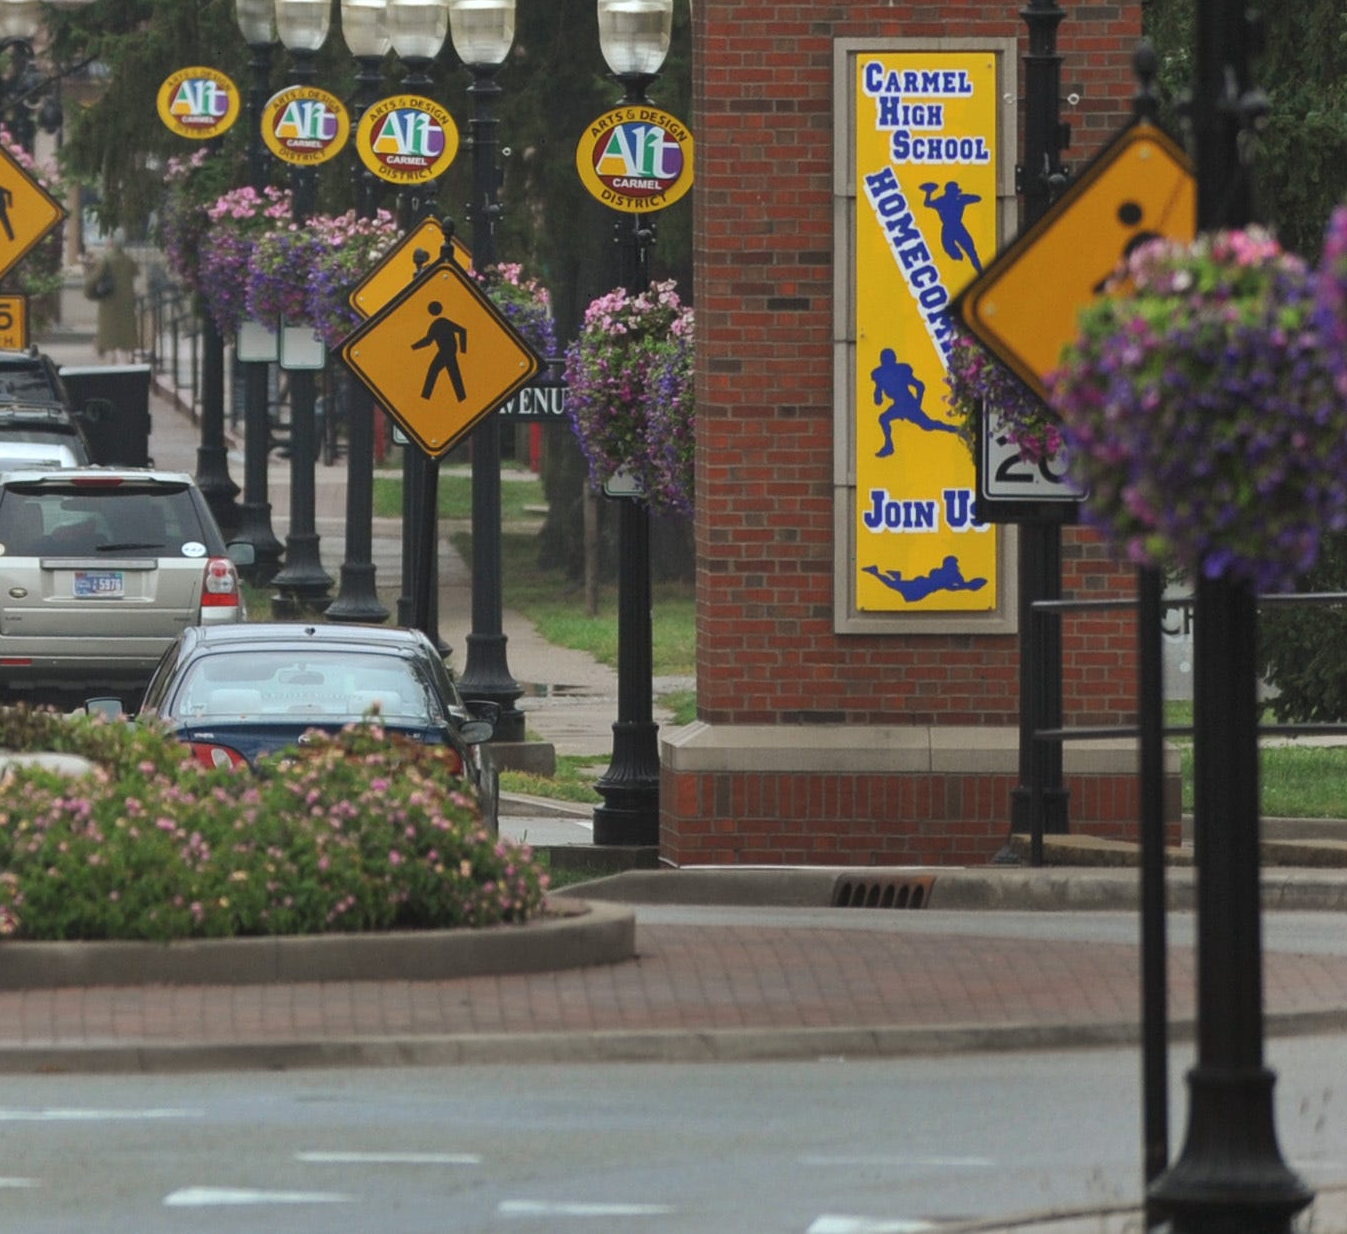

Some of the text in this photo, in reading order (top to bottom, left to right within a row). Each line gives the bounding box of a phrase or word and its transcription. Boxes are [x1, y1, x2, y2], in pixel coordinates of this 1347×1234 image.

[866, 63, 972, 93] CARMEL
[170, 79, 227, 117] Art
[369, 100, 396, 122] ARTS
[410, 98, 449, 125] DESIGN
[879, 96, 942, 126] HIGH
[274, 100, 336, 141] Art
[372, 111, 442, 157] Art
[591, 109, 687, 143] ARTS & DESIGN
[595, 125, 680, 179] Art
[893, 130, 989, 160] SCHOOL
[379, 165, 433, 180] DISTRICT
[386, 155, 428, 166] CARMEL
[601, 189, 667, 208] DISTRICT
[612, 178, 662, 190] CARMEL
[864, 490, 935, 528] JOIN
